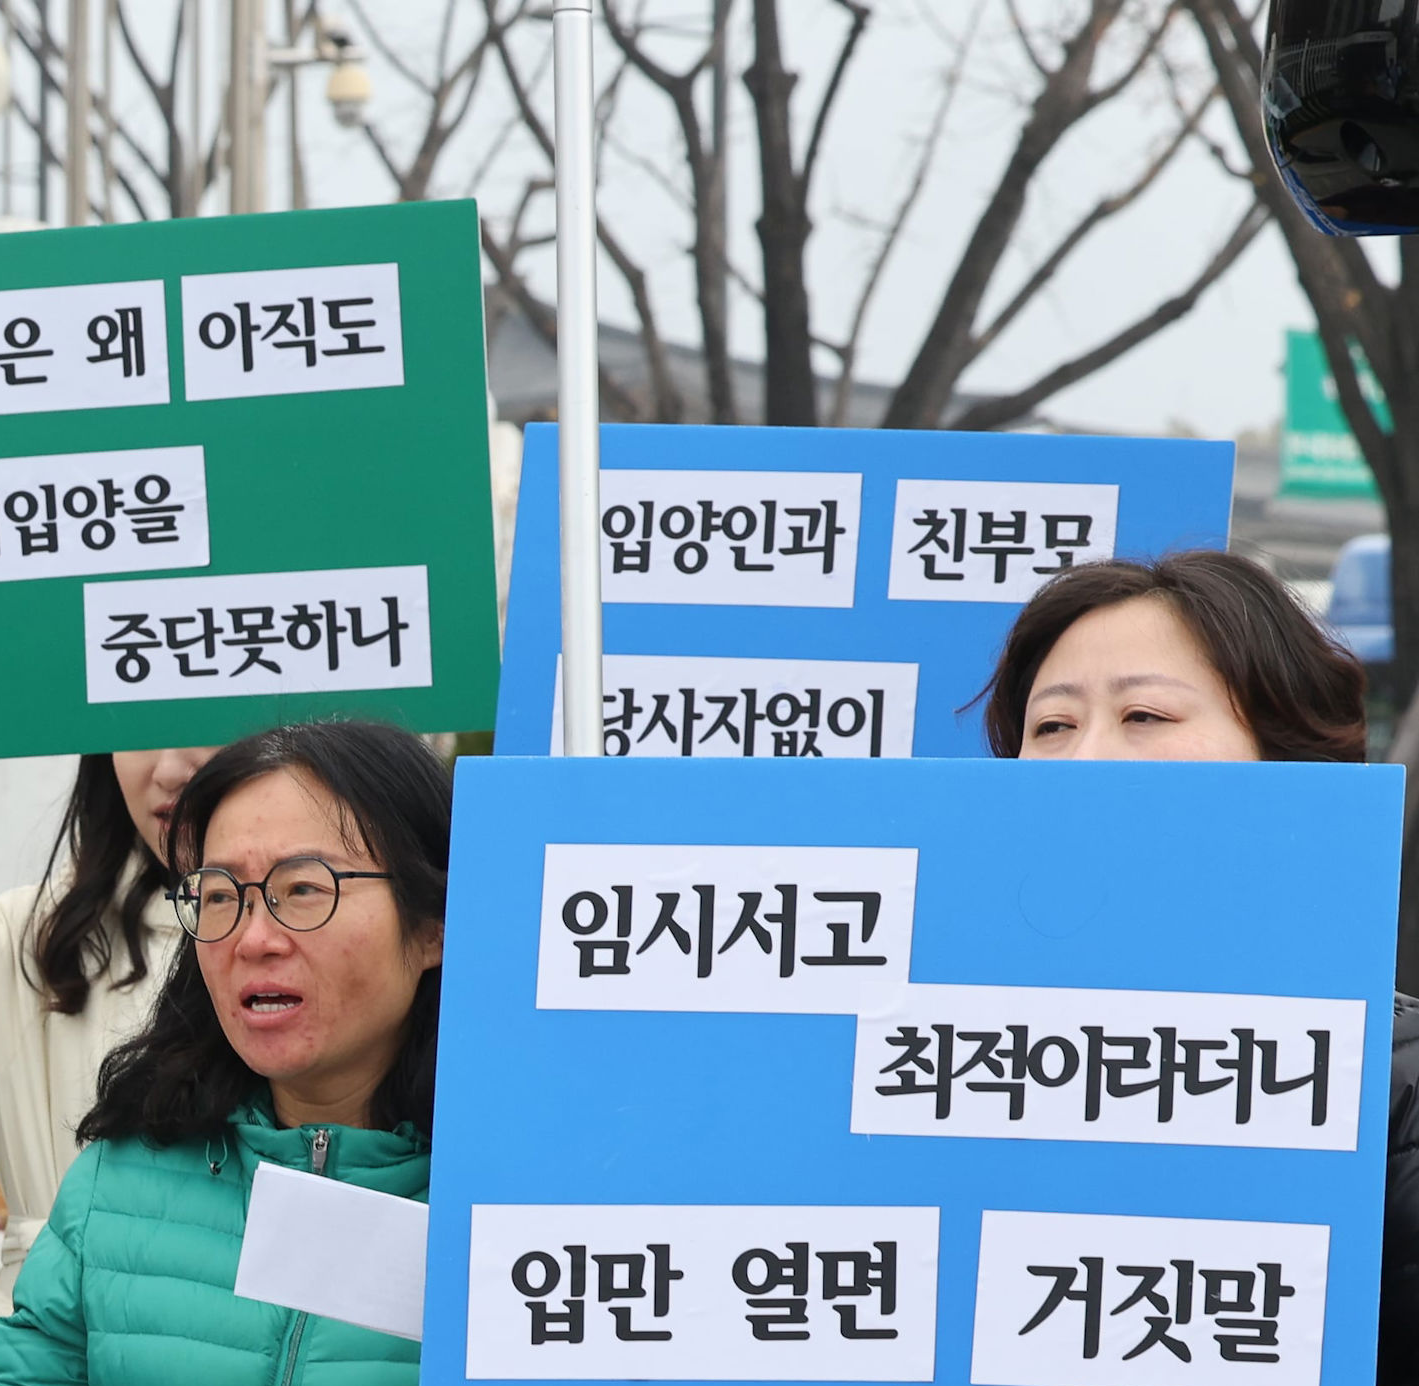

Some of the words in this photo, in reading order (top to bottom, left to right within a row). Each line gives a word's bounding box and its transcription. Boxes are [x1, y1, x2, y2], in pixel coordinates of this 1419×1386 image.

[87, 308, 145, 377] 왜
[199, 297, 385, 372] 아직도
[602, 501, 845, 574] 입양인과
[908, 509, 1094, 583] 친부모
[101, 597, 409, 684] 중단못하나
[562, 884, 887, 978] 임시서고
[875, 1025, 1330, 1126] 최적이라더니
[512, 1244, 683, 1345] 입만
[732, 1242, 898, 1340] 열면
[1019, 1257, 1295, 1363] 거짓말
